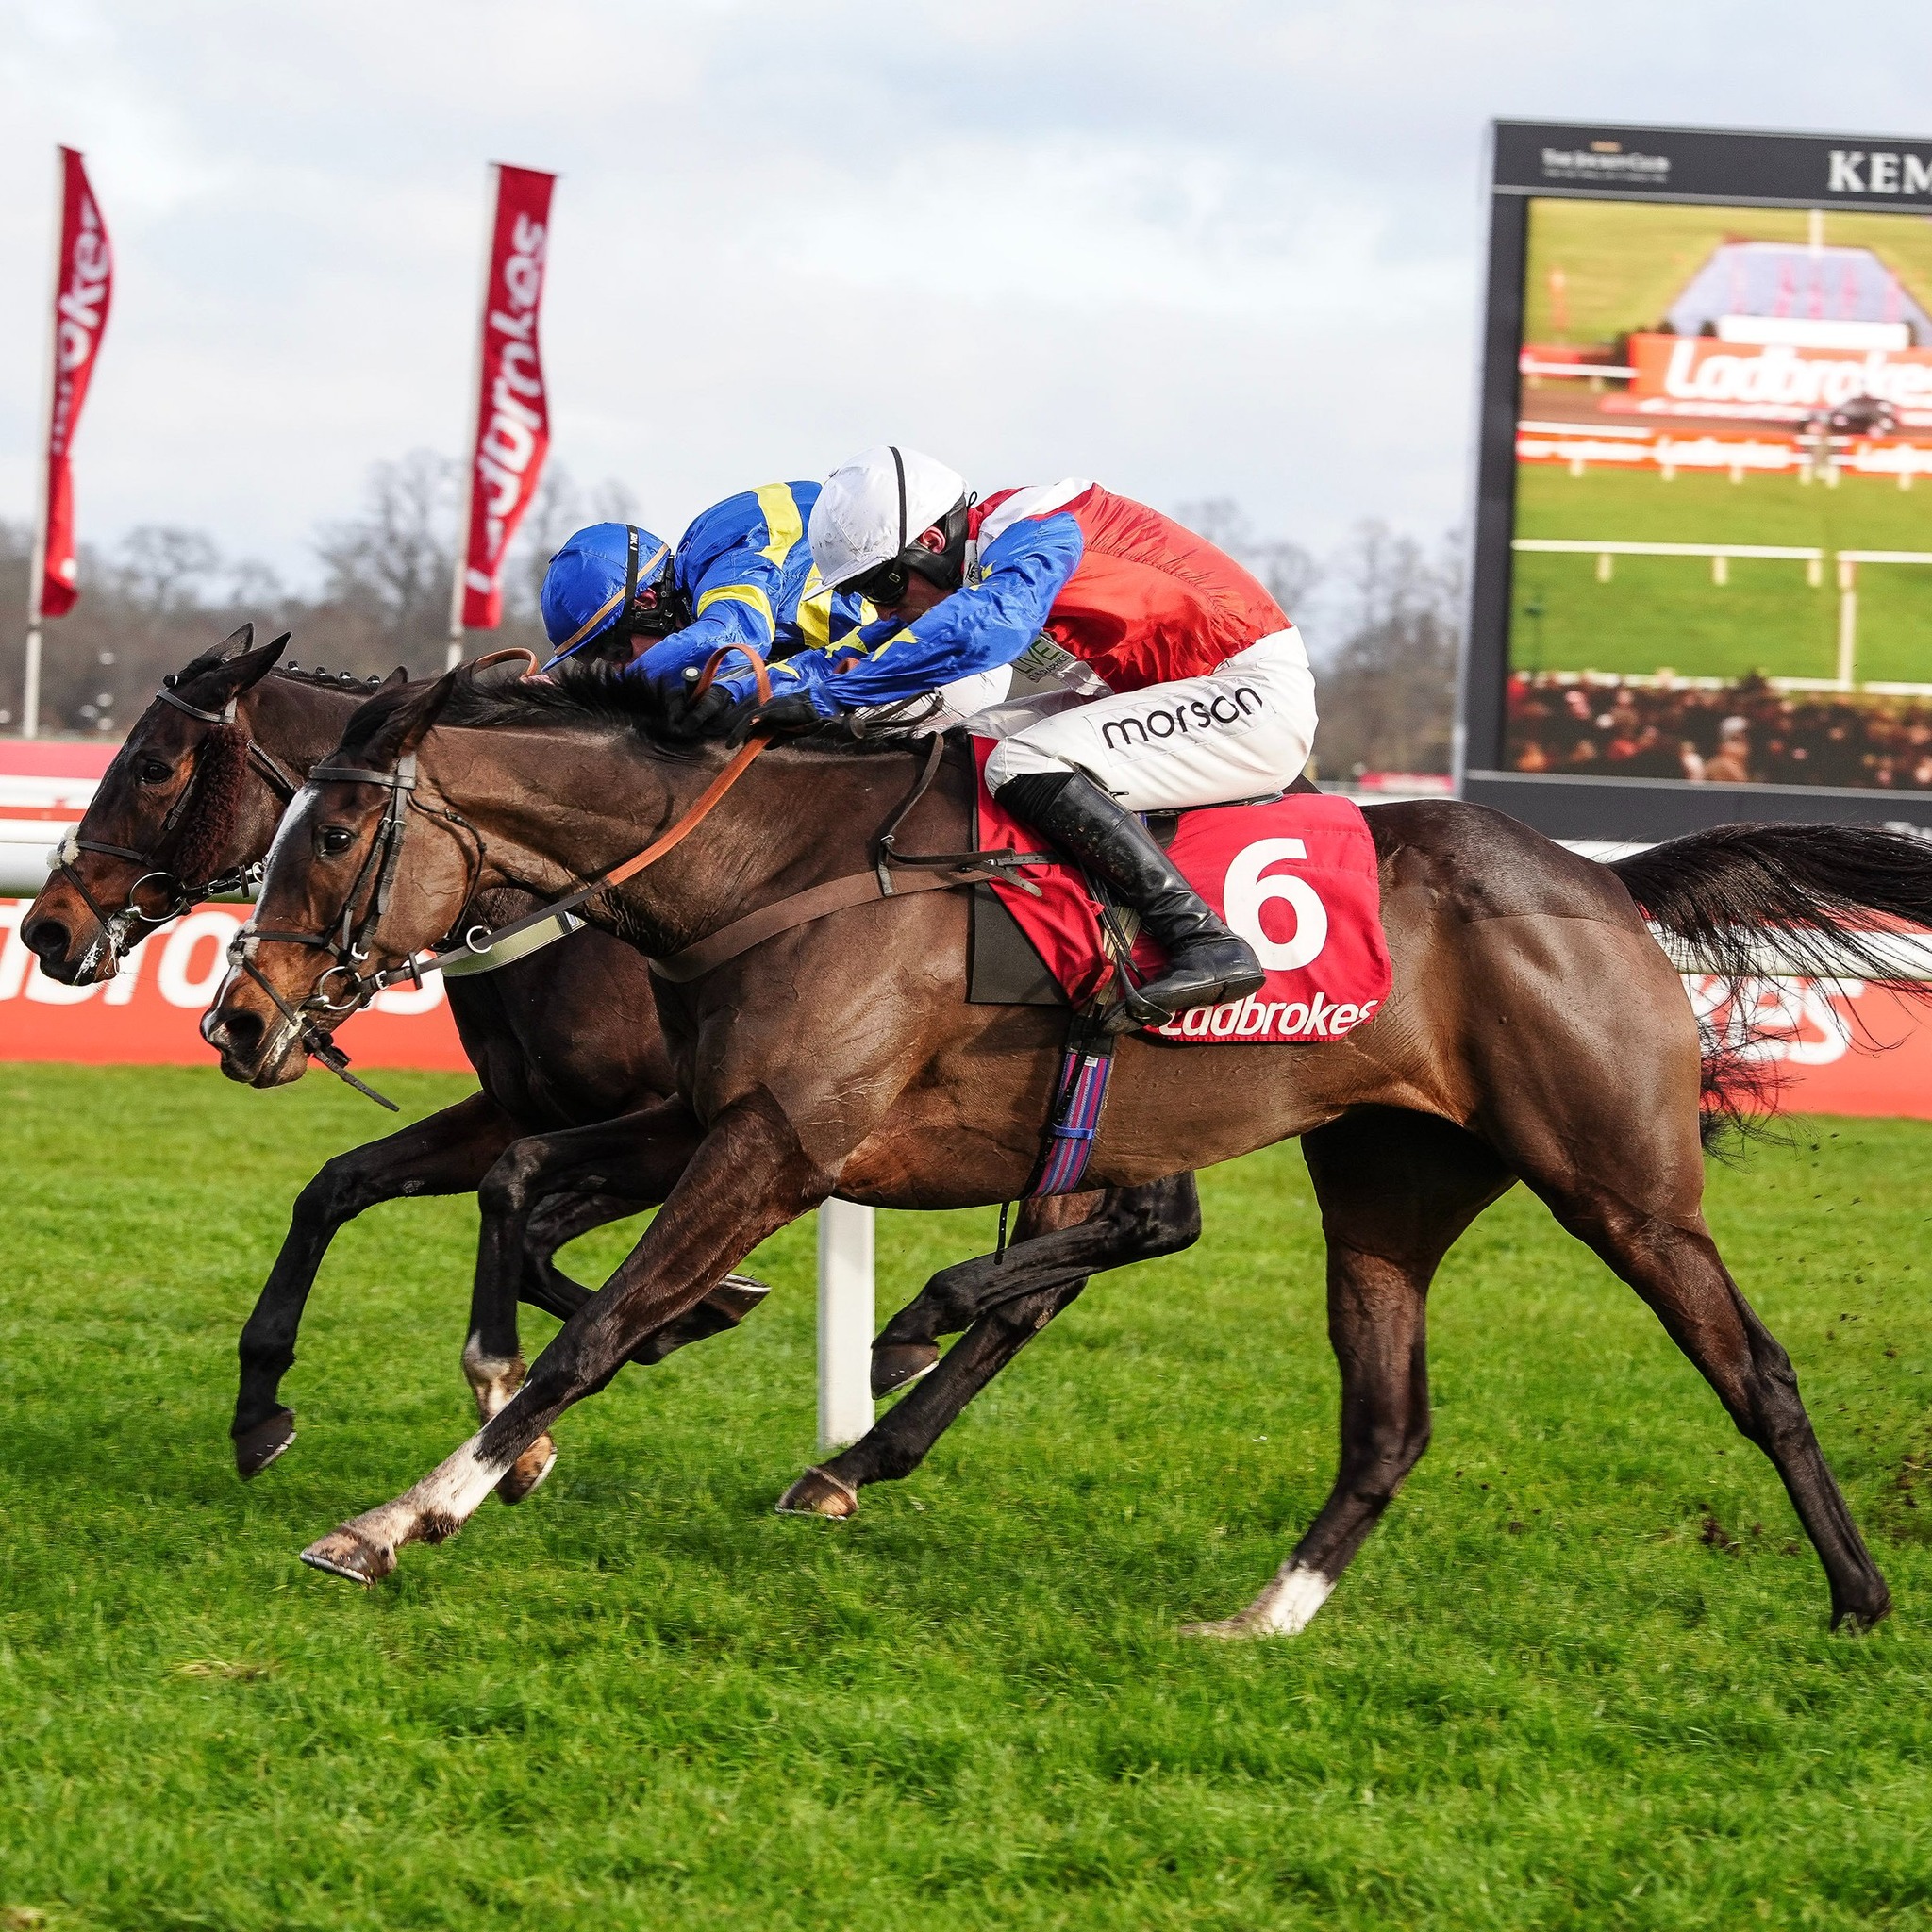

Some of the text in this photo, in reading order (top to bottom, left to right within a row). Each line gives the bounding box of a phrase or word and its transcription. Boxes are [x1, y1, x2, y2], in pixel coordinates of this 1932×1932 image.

[1010, 639, 1061, 674] LIVE
[1102, 687, 1262, 749] morson
[1223, 838, 1327, 971] 6
